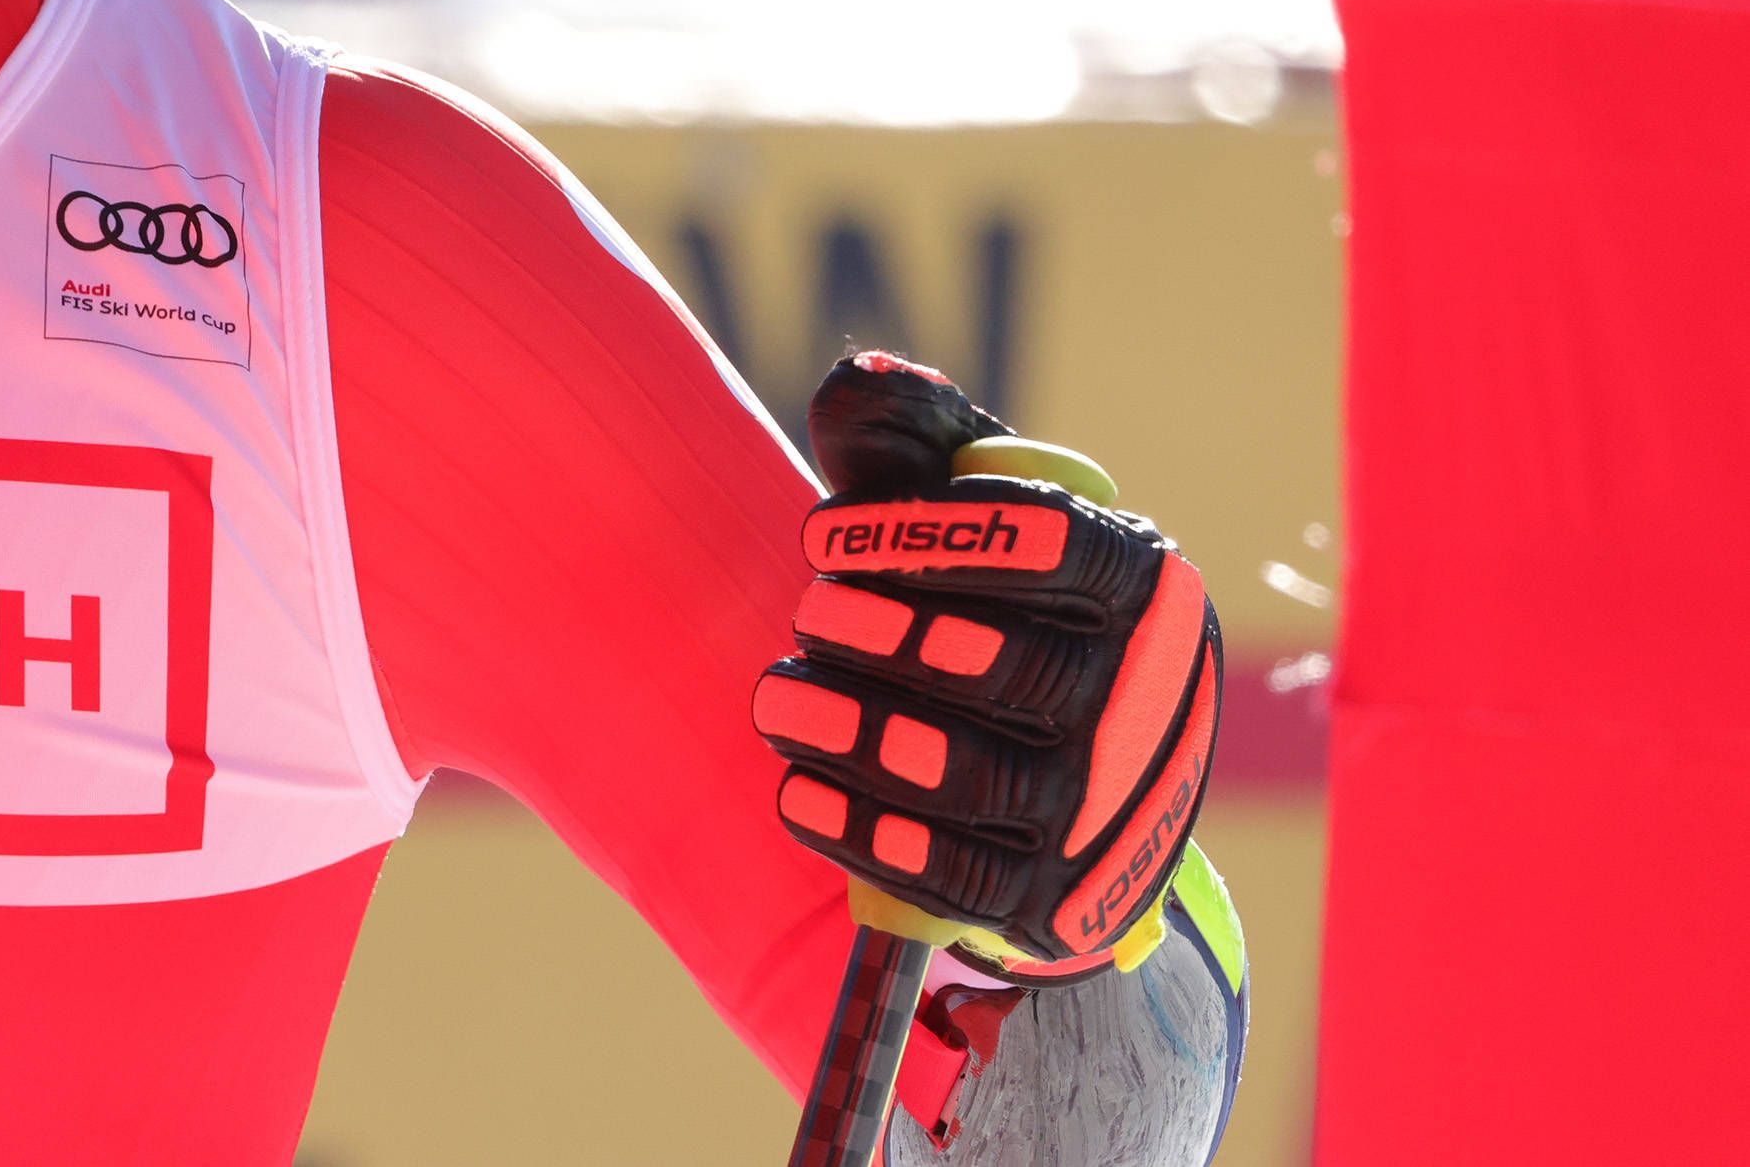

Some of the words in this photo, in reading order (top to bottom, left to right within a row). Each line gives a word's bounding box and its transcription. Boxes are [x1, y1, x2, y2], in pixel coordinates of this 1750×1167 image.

[62, 279, 110, 297] Audi
[61, 295, 93, 311] FIS
[100, 300, 128, 316] Ski
[134, 303, 196, 321] World
[202, 314, 236, 334] Cup
[826, 510, 1019, 557] reusch
[1081, 755, 1201, 937] reusch
